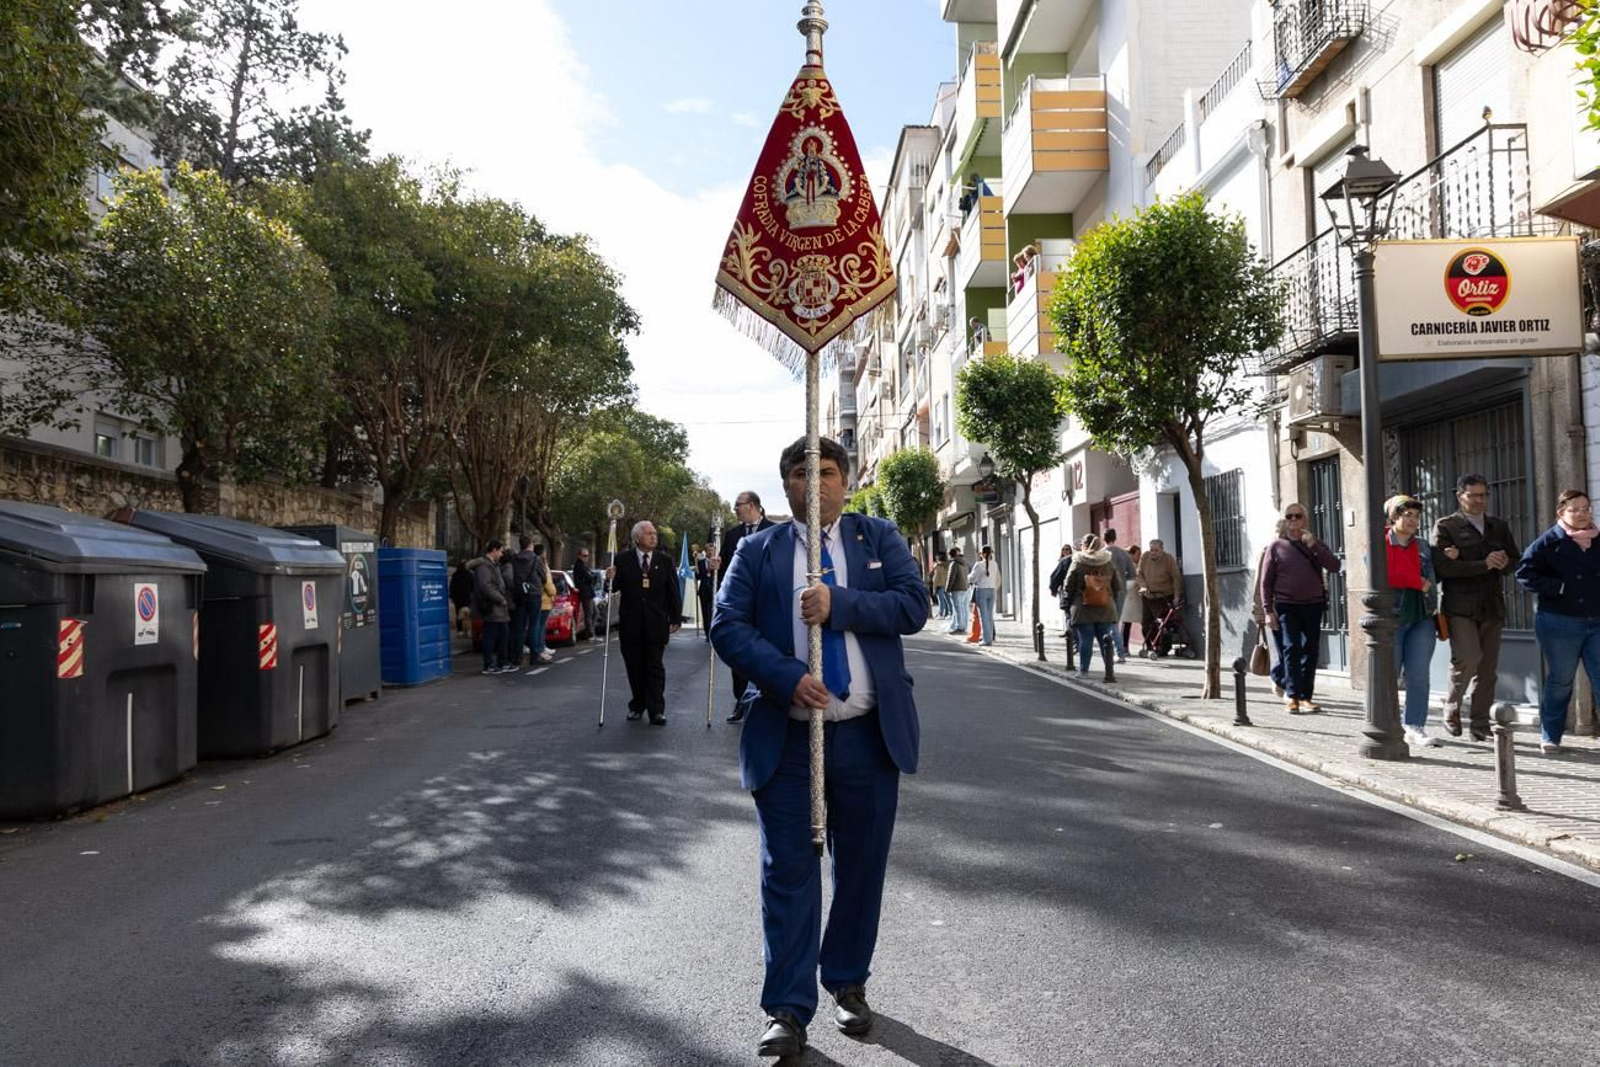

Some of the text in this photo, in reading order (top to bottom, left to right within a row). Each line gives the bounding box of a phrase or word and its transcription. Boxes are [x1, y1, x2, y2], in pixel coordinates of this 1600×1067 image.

[753, 174, 872, 251] COFRADIA VIRGEN DE LA CABEZA
[1457, 278, 1499, 298] Ortiz
[1411, 319, 1550, 336] CARNICERÍA JAVIER ORTIZ
